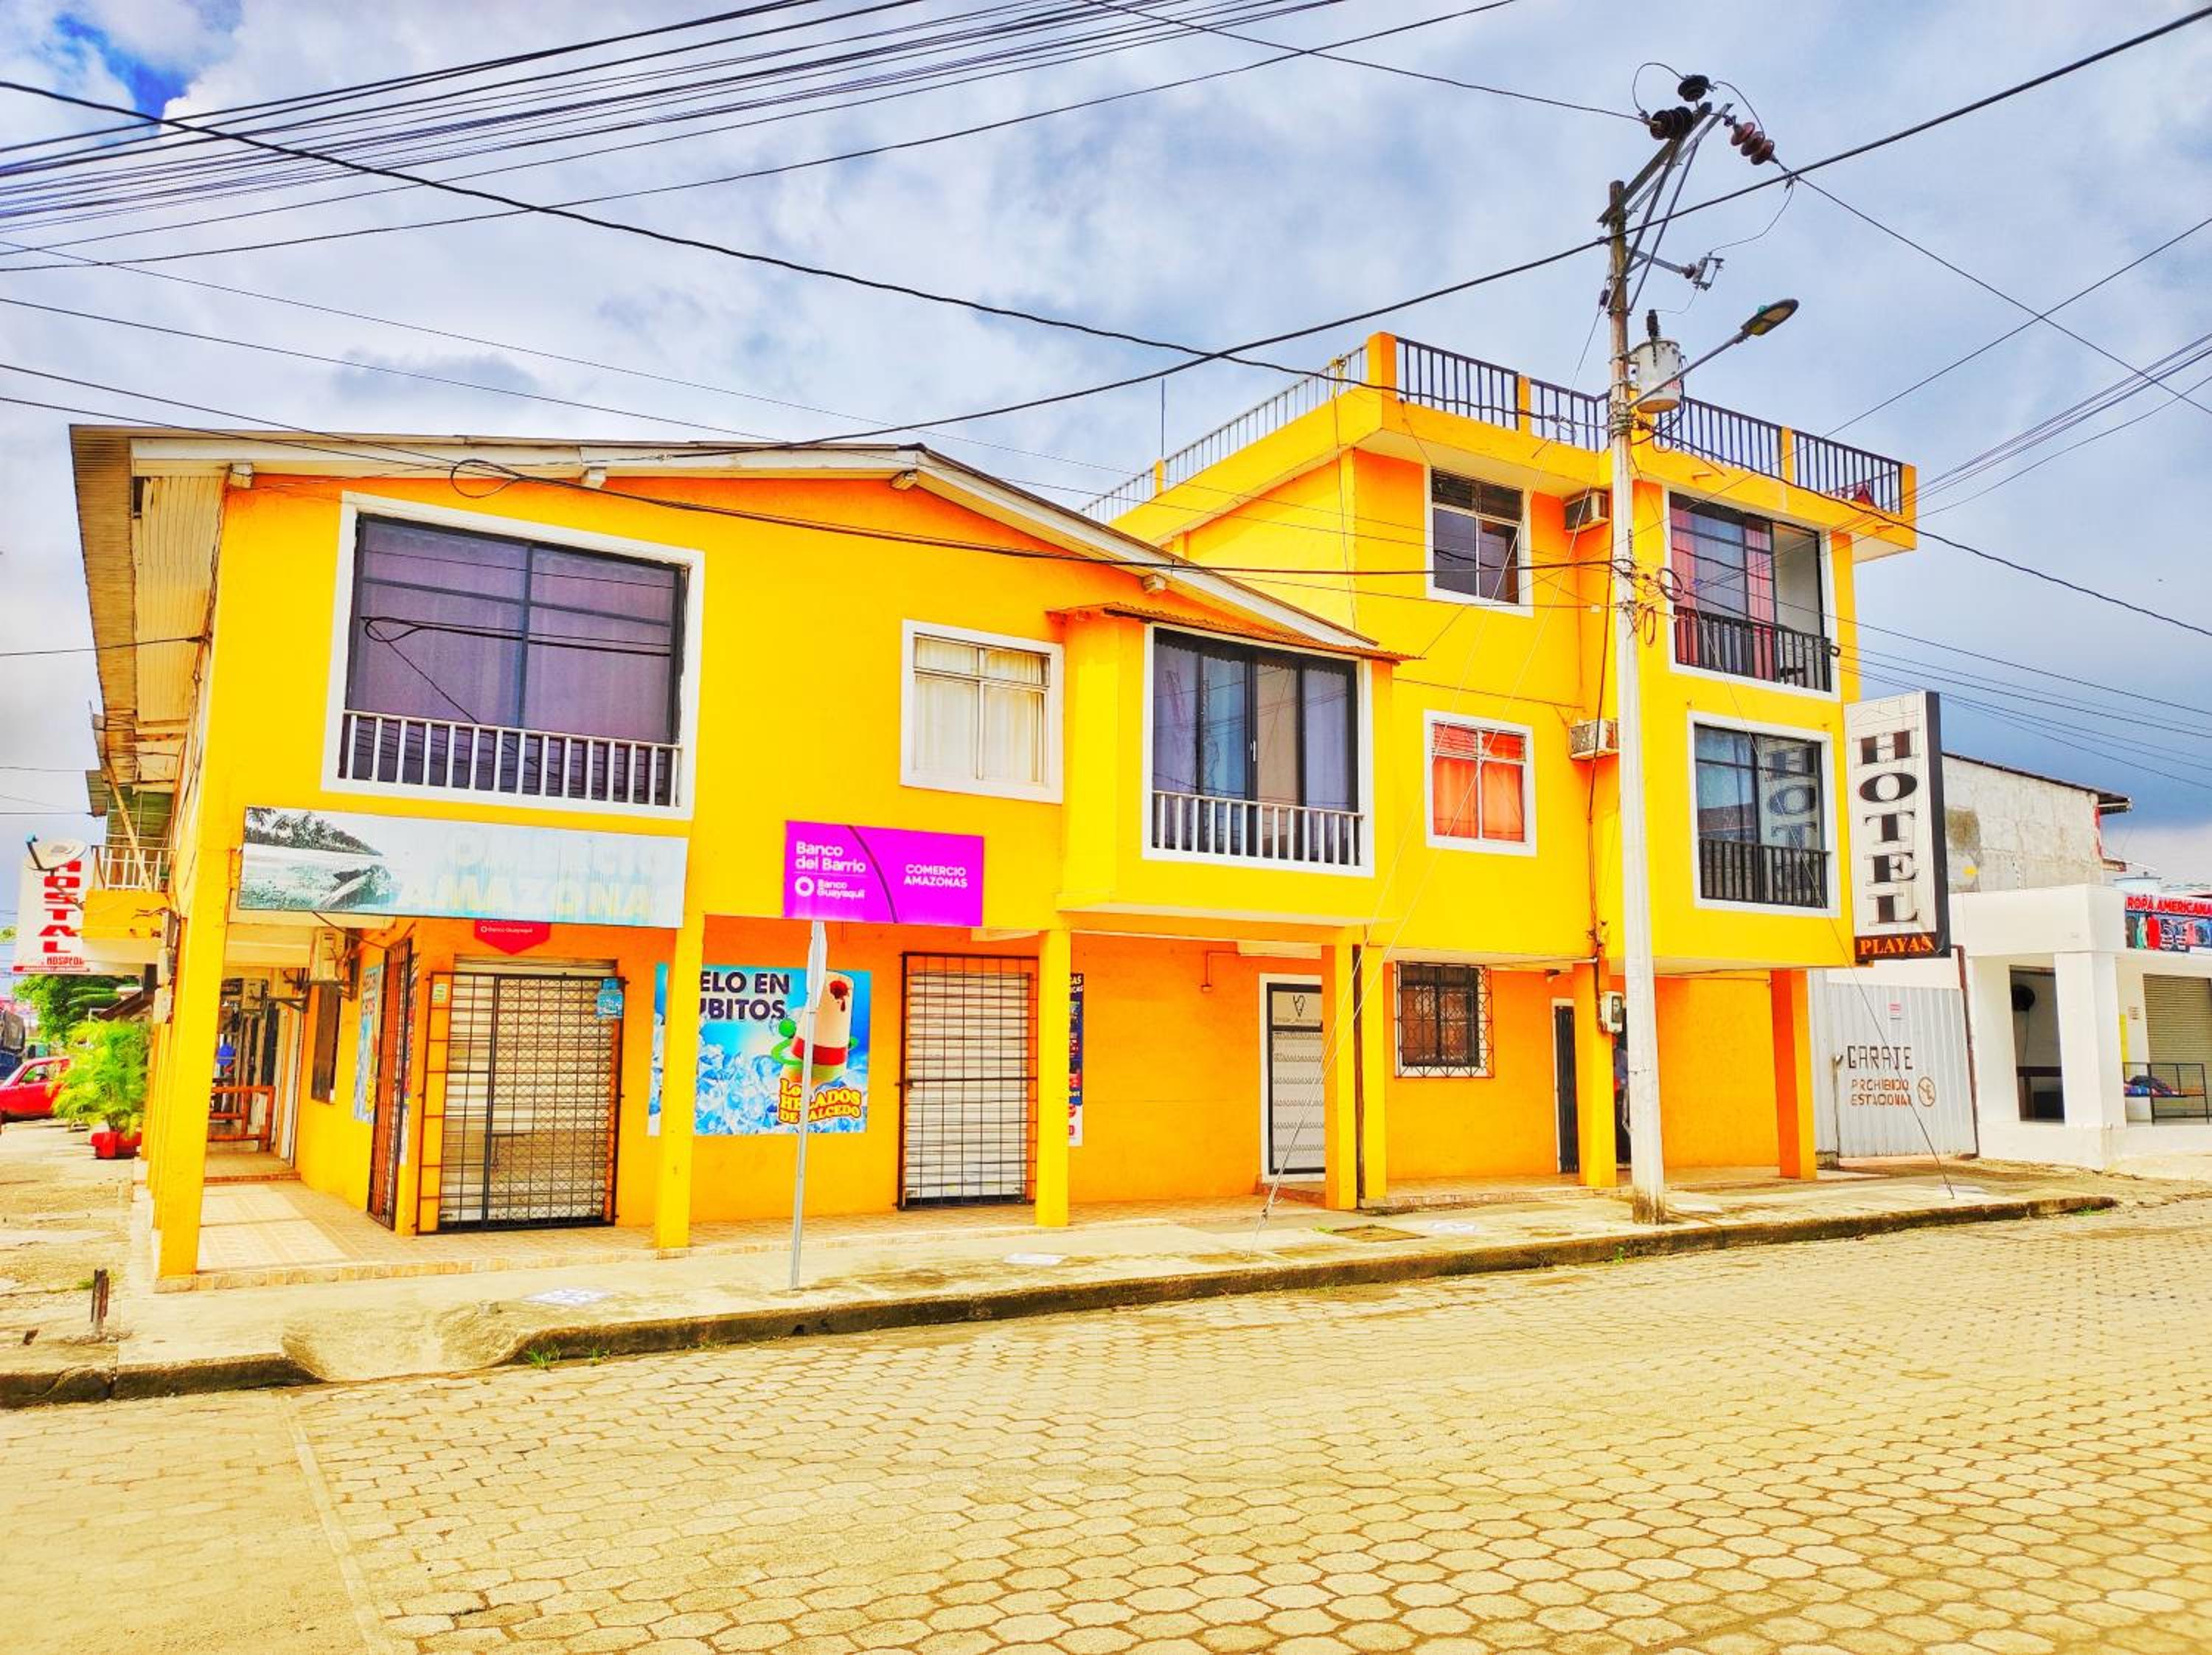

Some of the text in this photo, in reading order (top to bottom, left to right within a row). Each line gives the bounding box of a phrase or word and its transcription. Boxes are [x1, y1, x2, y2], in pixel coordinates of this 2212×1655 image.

[1853, 726, 1921, 926] HOTEL
[796, 841, 844, 856] Banco
[796, 856, 866, 872] del Barrio
[905, 864, 967, 876] COMERCIO
[818, 879, 847, 889] Banco
[904, 875, 967, 888] AMAZONAS
[817, 888, 865, 899] Guayaquil
[2126, 895, 2153, 910] ROPA
[1860, 935, 1935, 955] PLAYAS
[700, 971, 790, 994] ELO EN
[1847, 1045, 1913, 1070] GARAJE
[780, 1078, 804, 1097] Lo
[780, 1088, 862, 1111] HEADOS
[779, 1103, 861, 1124] DE ALCEDO
